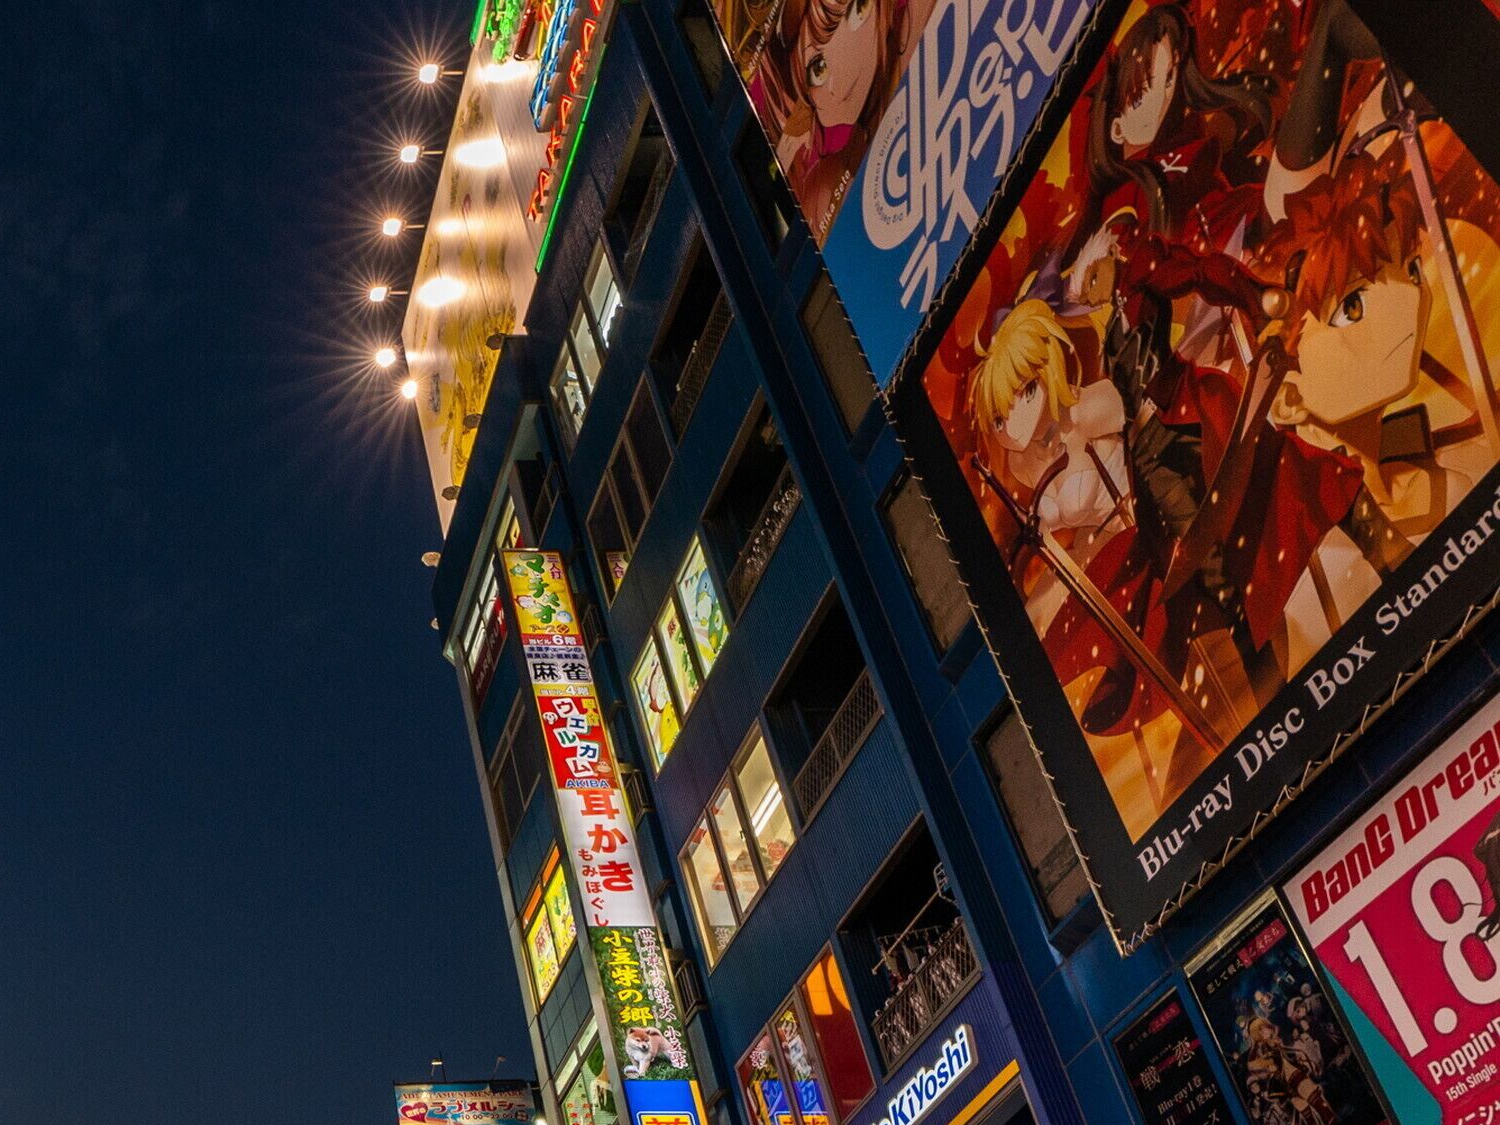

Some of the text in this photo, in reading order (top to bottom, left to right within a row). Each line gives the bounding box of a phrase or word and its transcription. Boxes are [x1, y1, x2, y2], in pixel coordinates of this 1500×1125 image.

[534, 661, 590, 682] 麻雀
[566, 778, 609, 788] AKIBA
[1136, 774, 1237, 883] Blu-ray
[1233, 707, 1305, 783] Disc
[1302, 643, 1380, 710] Box
[577, 789, 634, 893] 耳かき
[1300, 812, 1397, 926] BanG
[578, 848, 610, 928] もみほぐし
[1444, 1061, 1499, 1104] 15th Single
